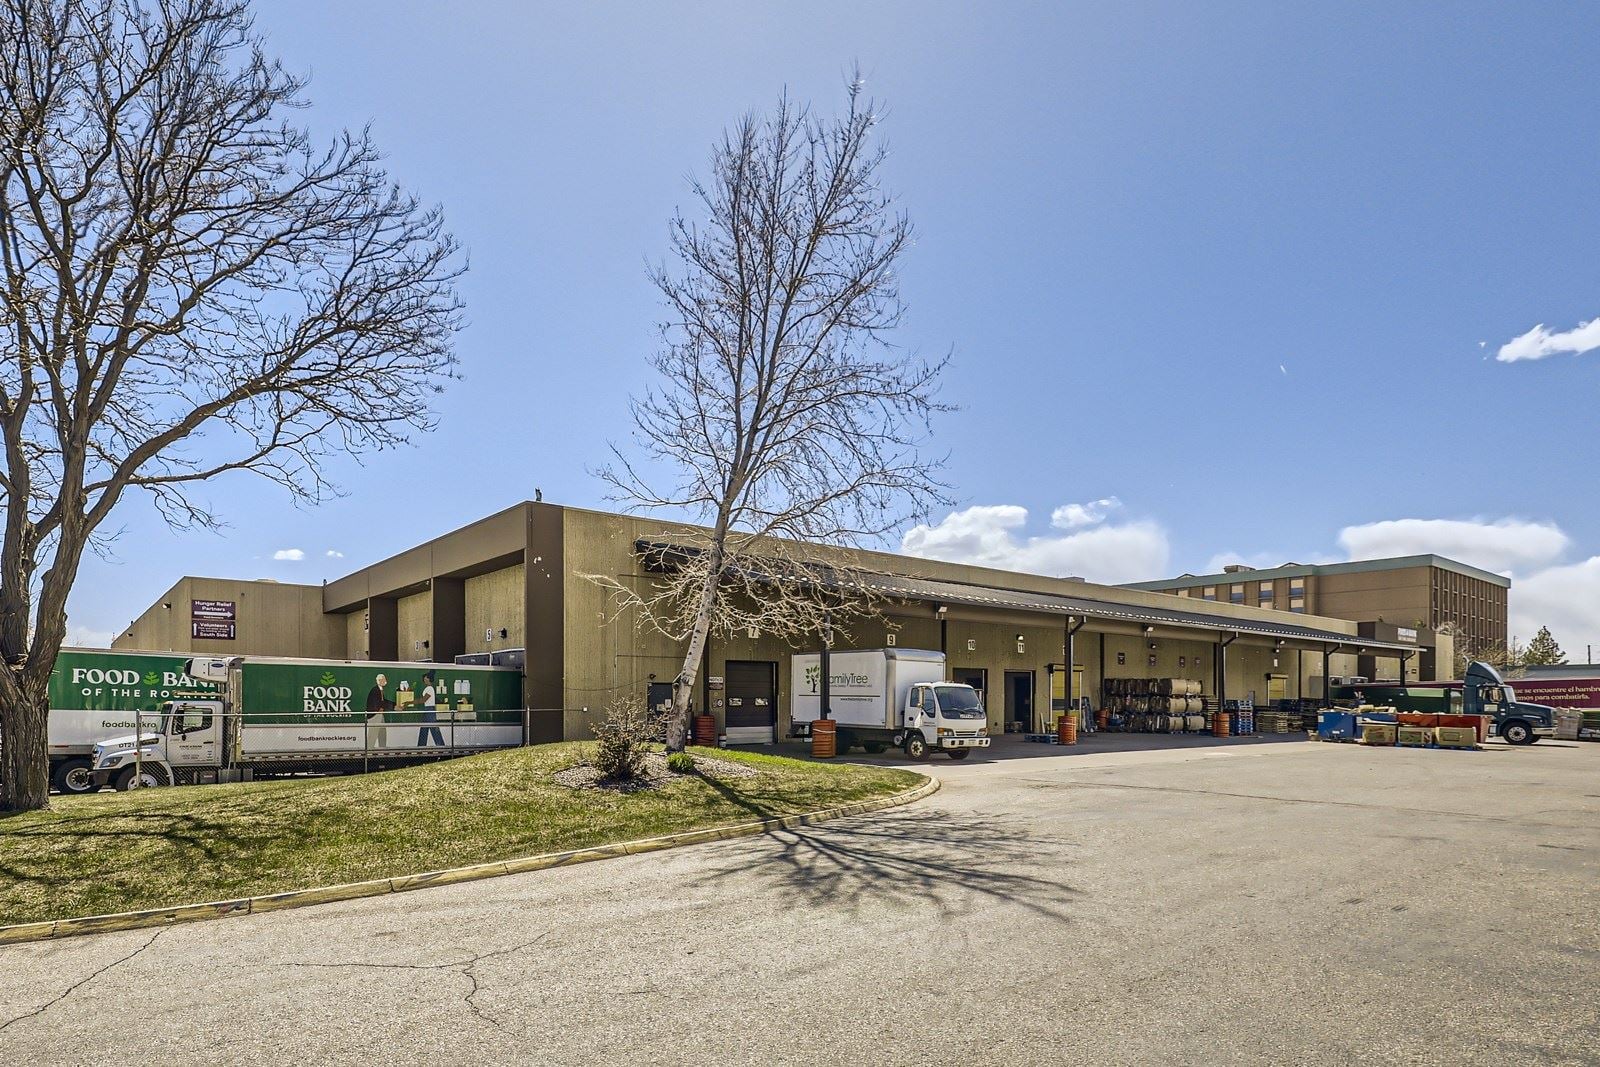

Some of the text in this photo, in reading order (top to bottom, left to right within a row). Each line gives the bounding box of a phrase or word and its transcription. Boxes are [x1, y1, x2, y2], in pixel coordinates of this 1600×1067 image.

[888, 635, 894, 644] 9
[72, 668, 140, 685] FOOD
[829, 672, 868, 686] amilyTree
[81, 688, 103, 697] OF
[112, 688, 141, 697] THE
[303, 686, 352, 699] FOOD
[303, 700, 351, 712] BANK
[102, 720, 157, 728] foodbakro
